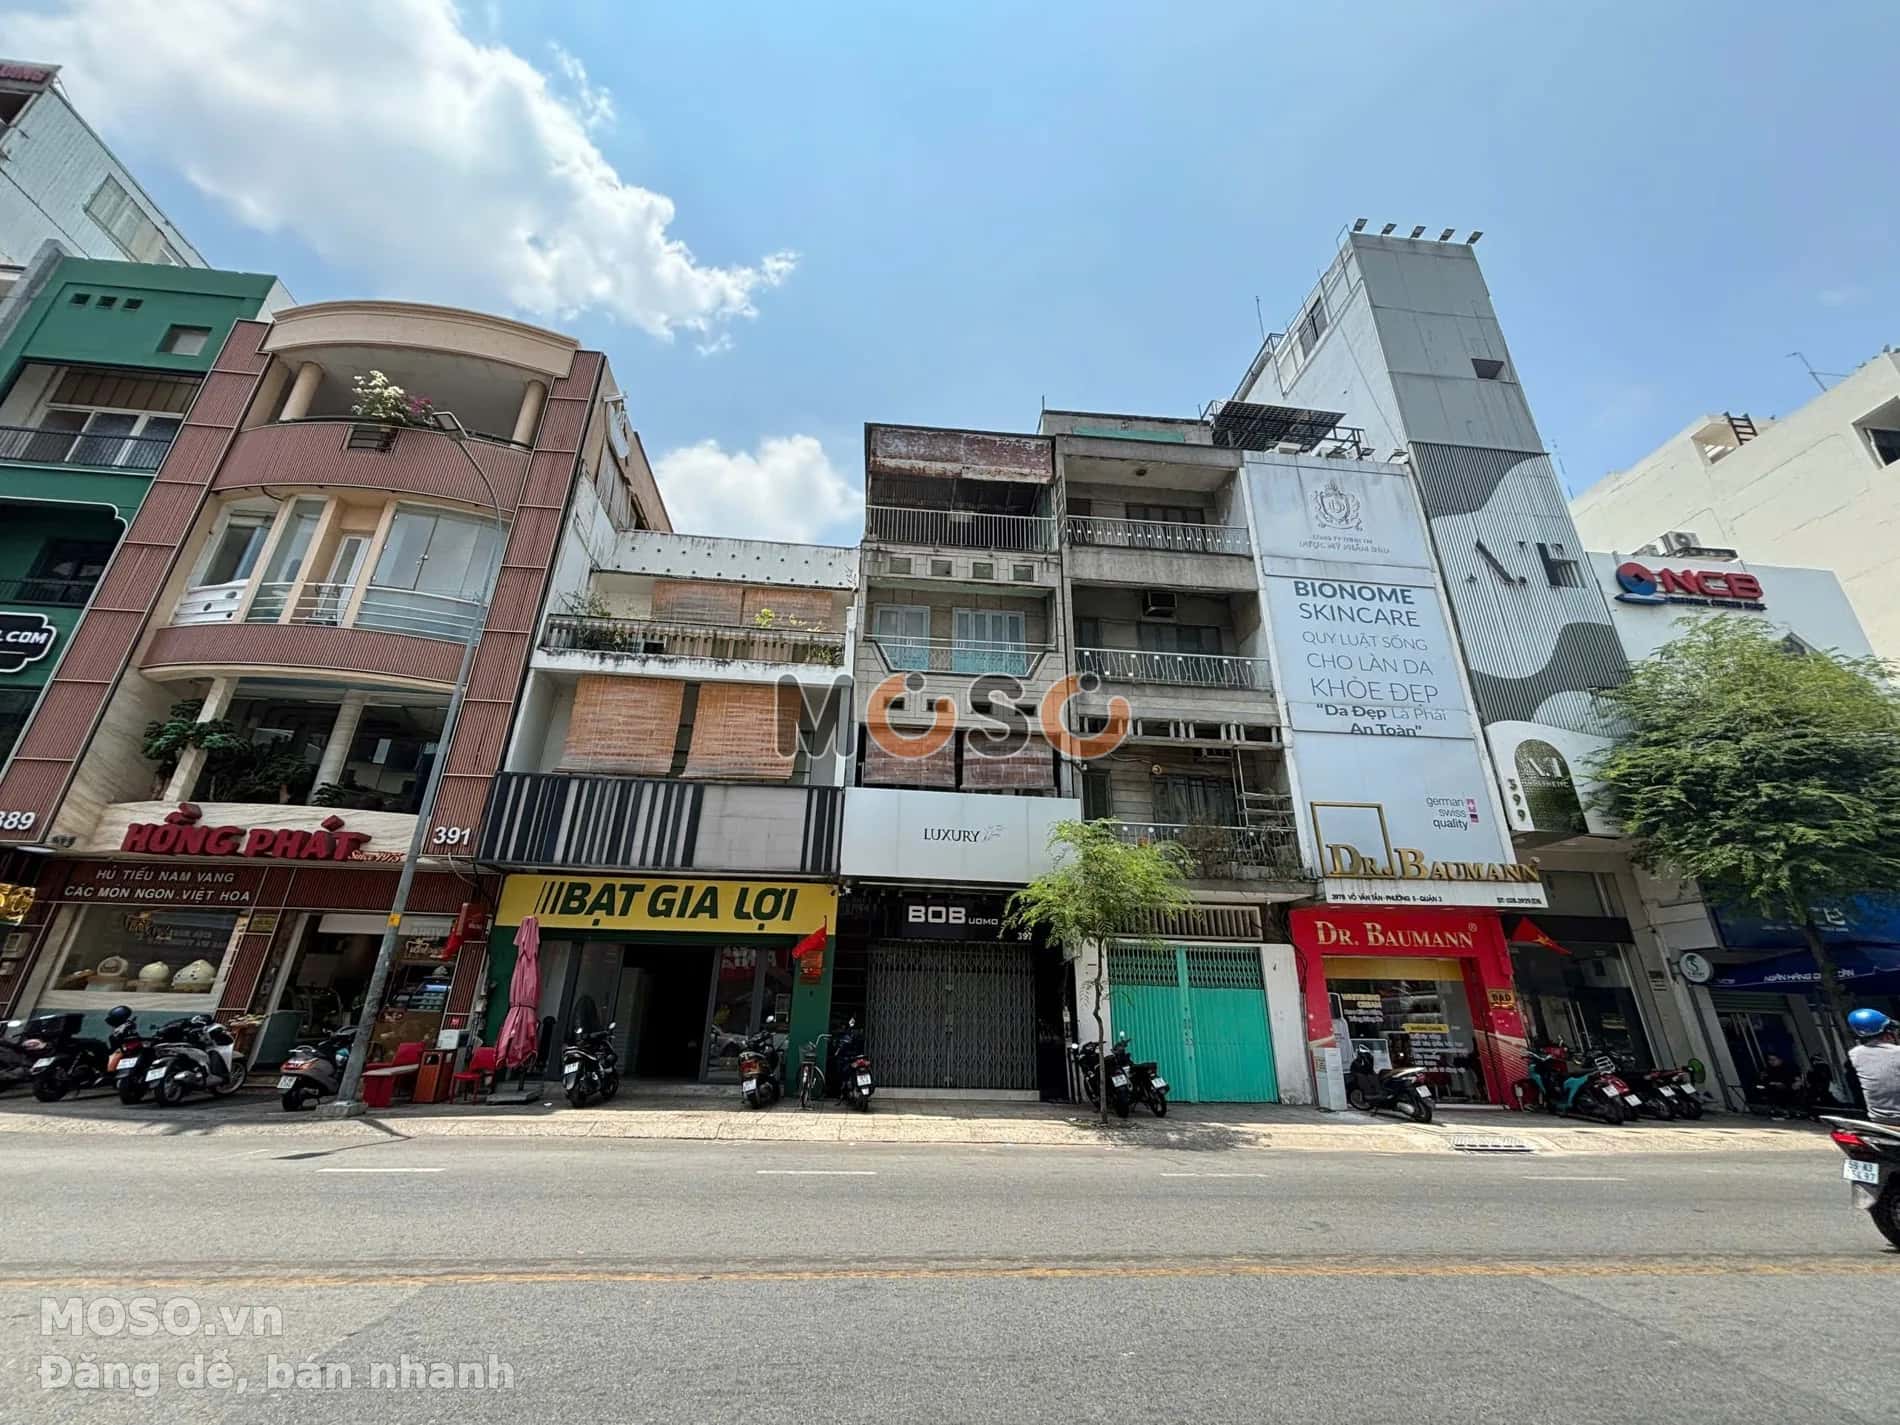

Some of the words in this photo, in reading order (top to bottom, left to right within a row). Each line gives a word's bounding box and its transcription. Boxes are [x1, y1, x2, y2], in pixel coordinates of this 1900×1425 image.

[1293, 580, 1415, 605] BIONOME
[1657, 567, 1764, 599] NCB
[1299, 603, 1421, 627] SKINCARE
[1302, 630, 1337, 645] QUY
[1382, 634, 1428, 651] SỐNG
[1307, 653, 1353, 670] CHO
[1359, 653, 1398, 673] LÀN
[1403, 659, 1434, 676] DA
[1310, 675, 1385, 700] KHỎE
[1388, 682, 1439, 707] ĐẸP
[1352, 705, 1387, 721] Đẹp
[1350, 722, 1374, 735] An
[1425, 797, 1465, 808] german
[1438, 808, 1467, 818] swiss
[1432, 818, 1468, 831] quality
[244, 814, 372, 862] PHÁT
[432, 826, 472, 846] 391
[924, 828, 981, 843] LUXURY
[123, 866, 153, 880] TIẾU
[158, 871, 192, 881] NAM
[197, 872, 235, 883] VANG
[1394, 847, 1540, 882] BAUMANN
[64, 882, 94, 897] CÁC
[97, 883, 131, 898] MÓN
[220, 890, 250, 902] HOA
[558, 881, 645, 926] BẠT
[647, 883, 719, 919] GIA
[733, 886, 801, 931] LỢI
[908, 905, 966, 924] BOB
[968, 917, 999, 926] UOMO
